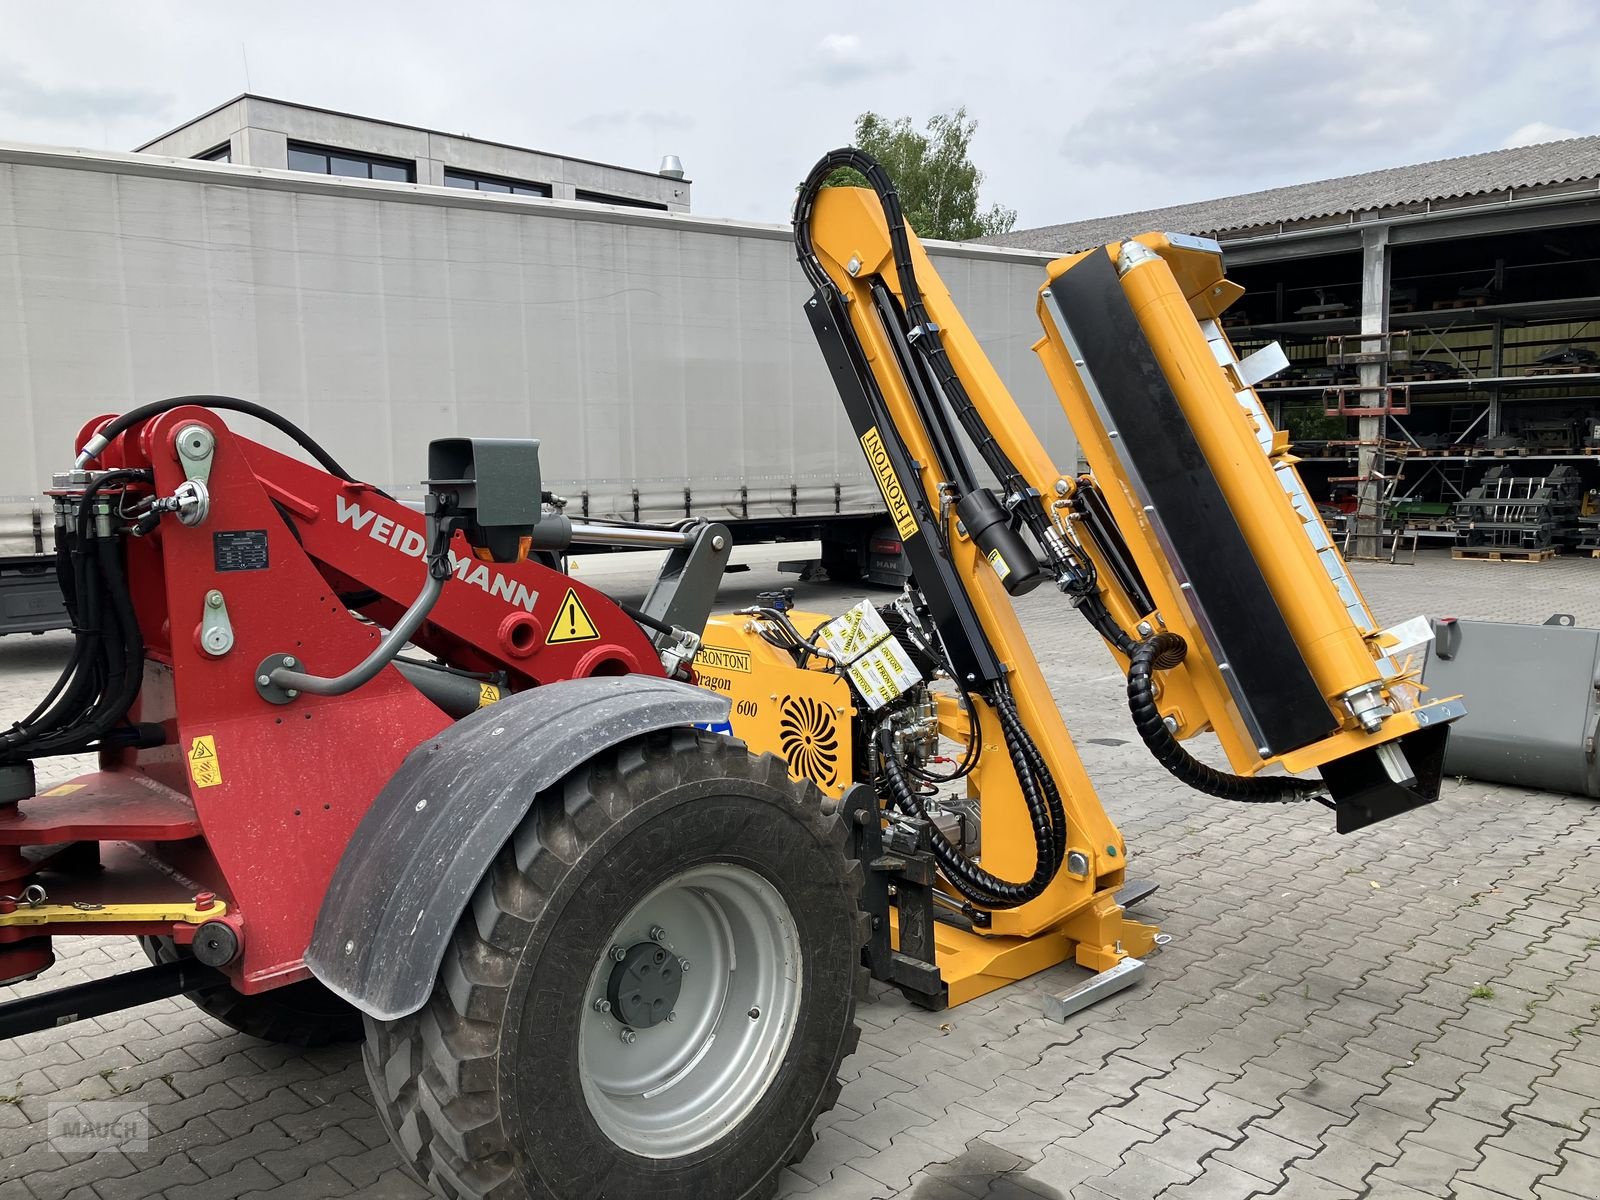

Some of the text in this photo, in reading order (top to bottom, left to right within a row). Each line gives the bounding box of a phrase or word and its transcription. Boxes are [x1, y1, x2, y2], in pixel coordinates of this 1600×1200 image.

[863, 432, 911, 525] FRONTONI
[336, 495, 539, 612] WEIDMANN
[695, 650, 749, 671] FRONTONI
[736, 700, 758, 717] 600
